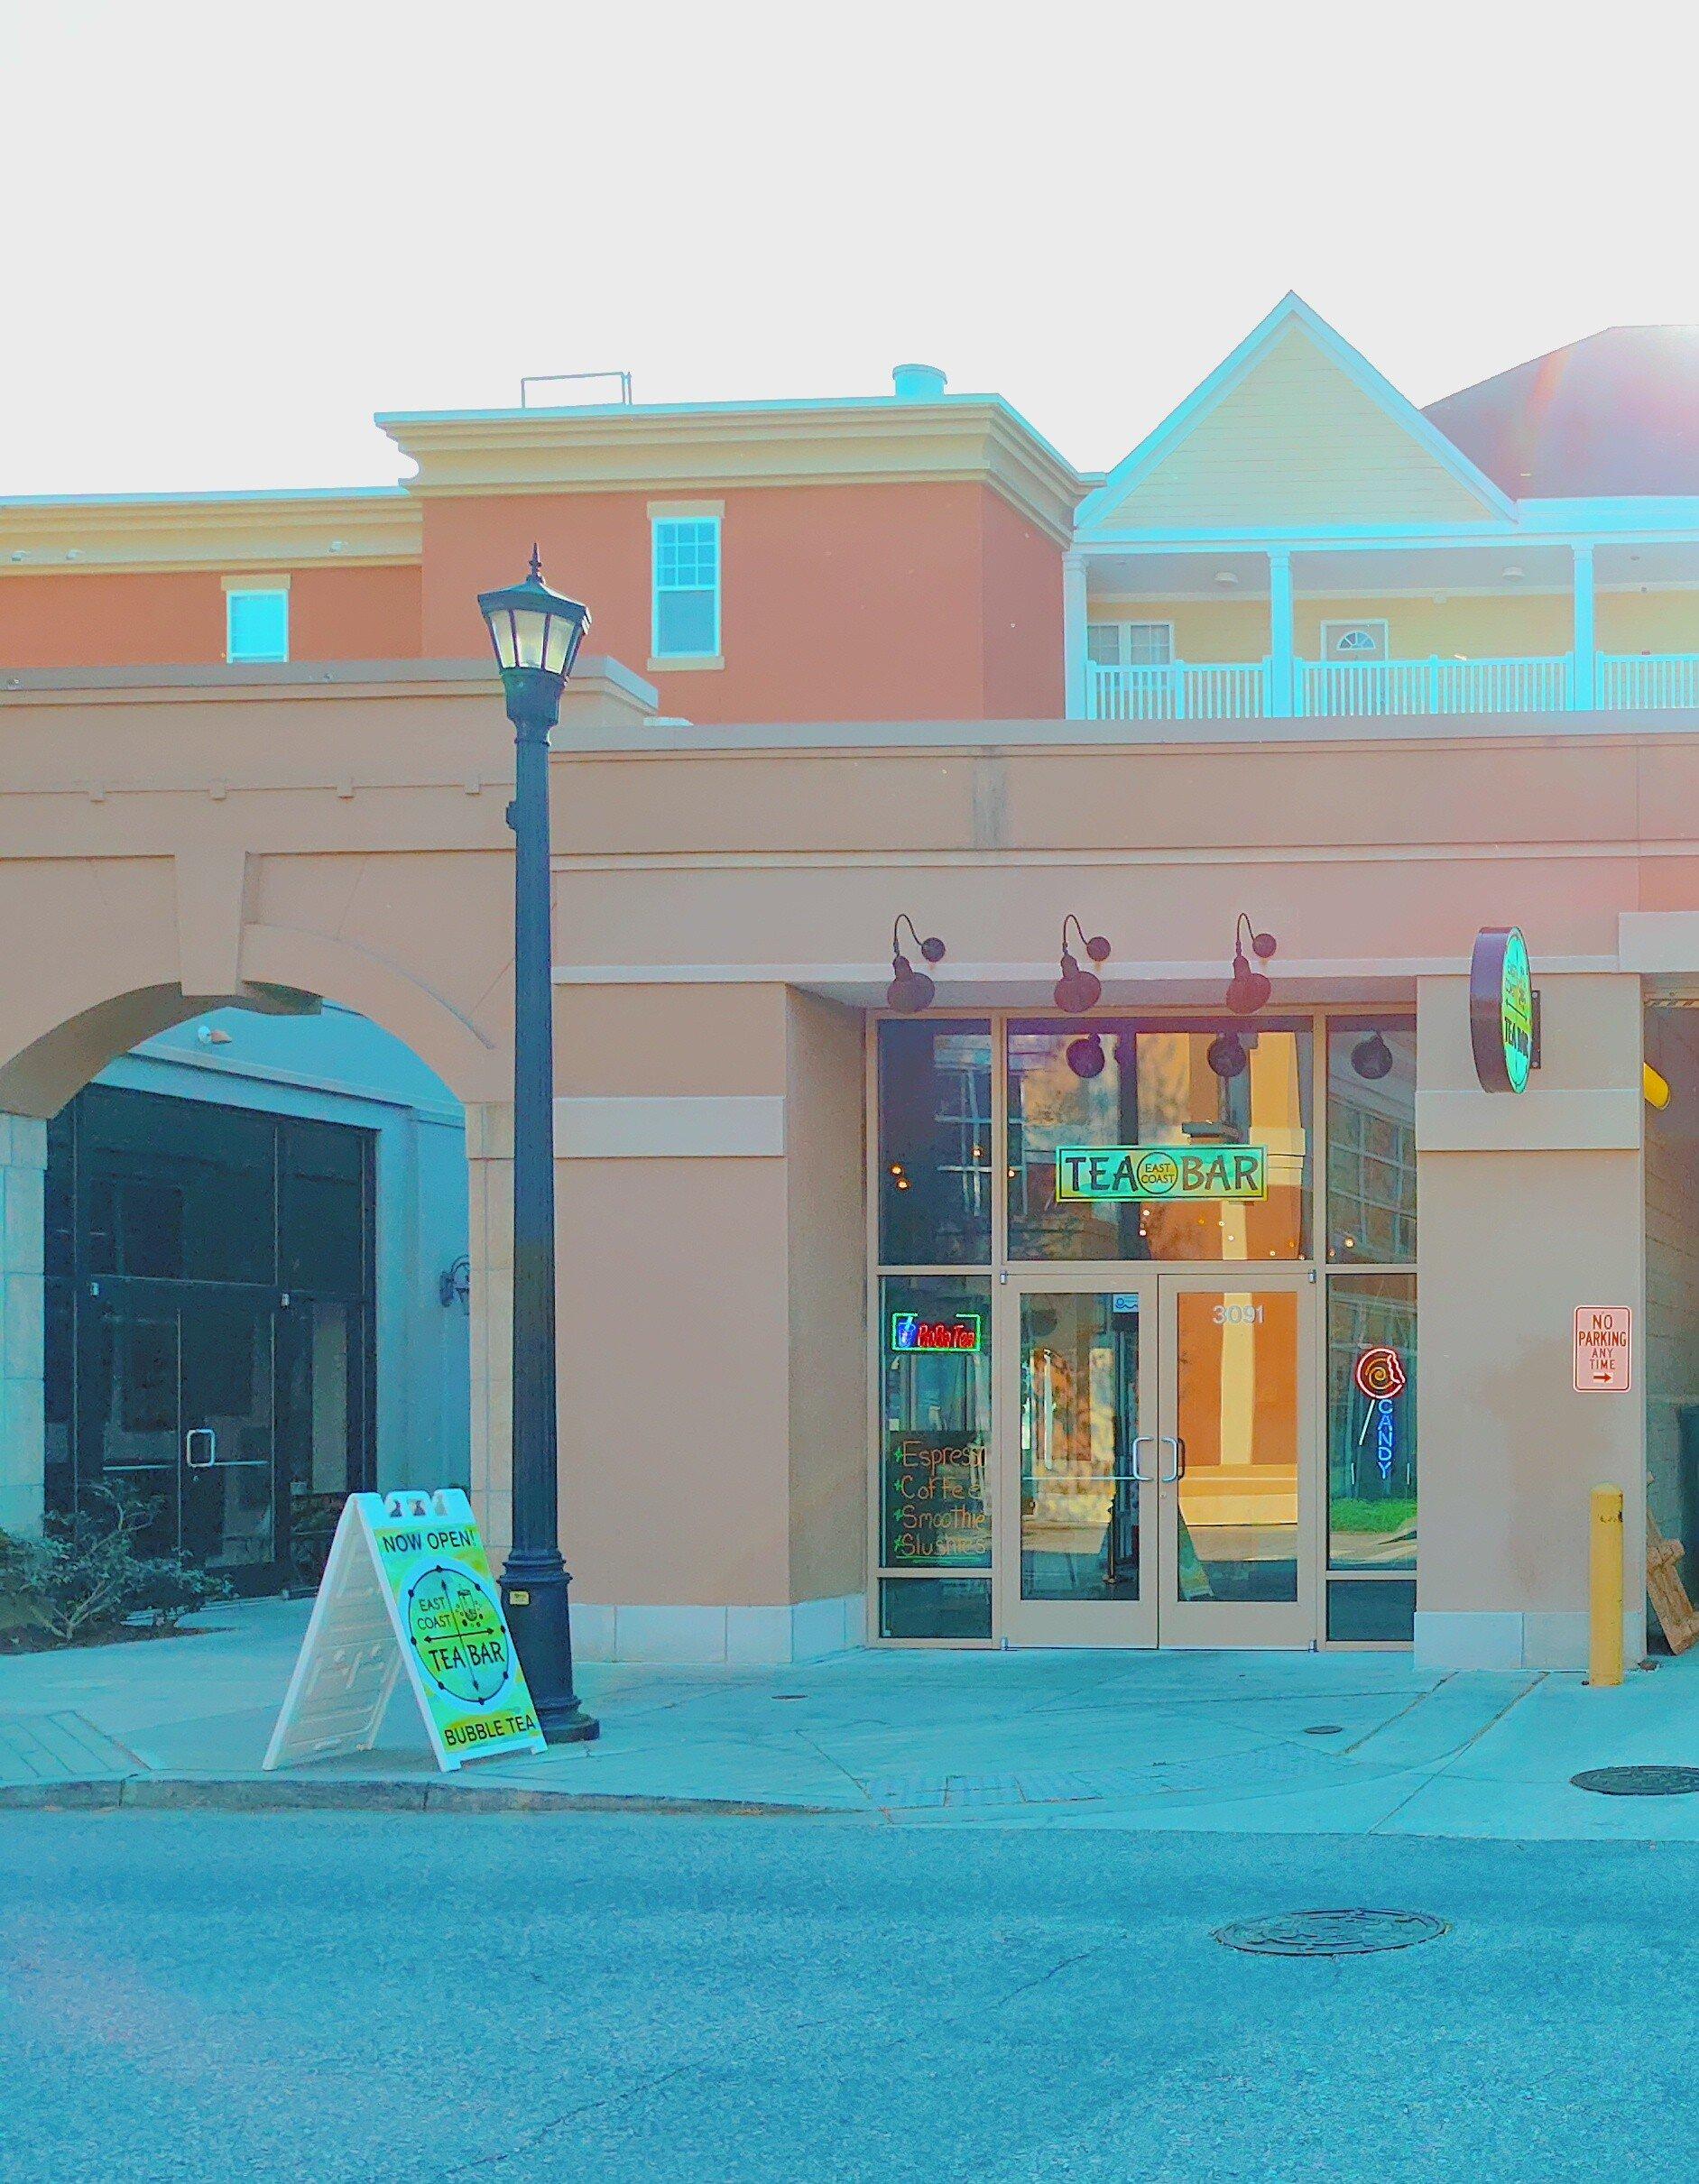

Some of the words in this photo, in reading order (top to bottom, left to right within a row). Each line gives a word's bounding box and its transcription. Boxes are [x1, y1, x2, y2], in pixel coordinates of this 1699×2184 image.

[1065, 1155, 1139, 1192] TEA
[1180, 1155, 1259, 1192] BAR
[1144, 1163, 1170, 1173] EAST
[1141, 1174, 1175, 1184] COAST
[1213, 1304, 1264, 1324] 3091
[1592, 1314, 1613, 1330] NO
[1578, 1331, 1627, 1347] PARKING
[1592, 1348, 1613, 1359] ANY
[1590, 1359, 1616, 1370] TIME
[1377, 1398, 1394, 1479] CANDY
[901, 1474, 982, 1499] Coffee
[383, 1534, 422, 1553] NOW
[427, 1530, 476, 1552] OPEN!
[418, 1596, 446, 1612] EAST
[416, 1614, 451, 1631] COAST
[429, 1646, 466, 1673] TEA
[466, 1642, 505, 1666] BAR
[444, 1719, 505, 1746] BUBBLE
[507, 1714, 537, 1735] TEA
